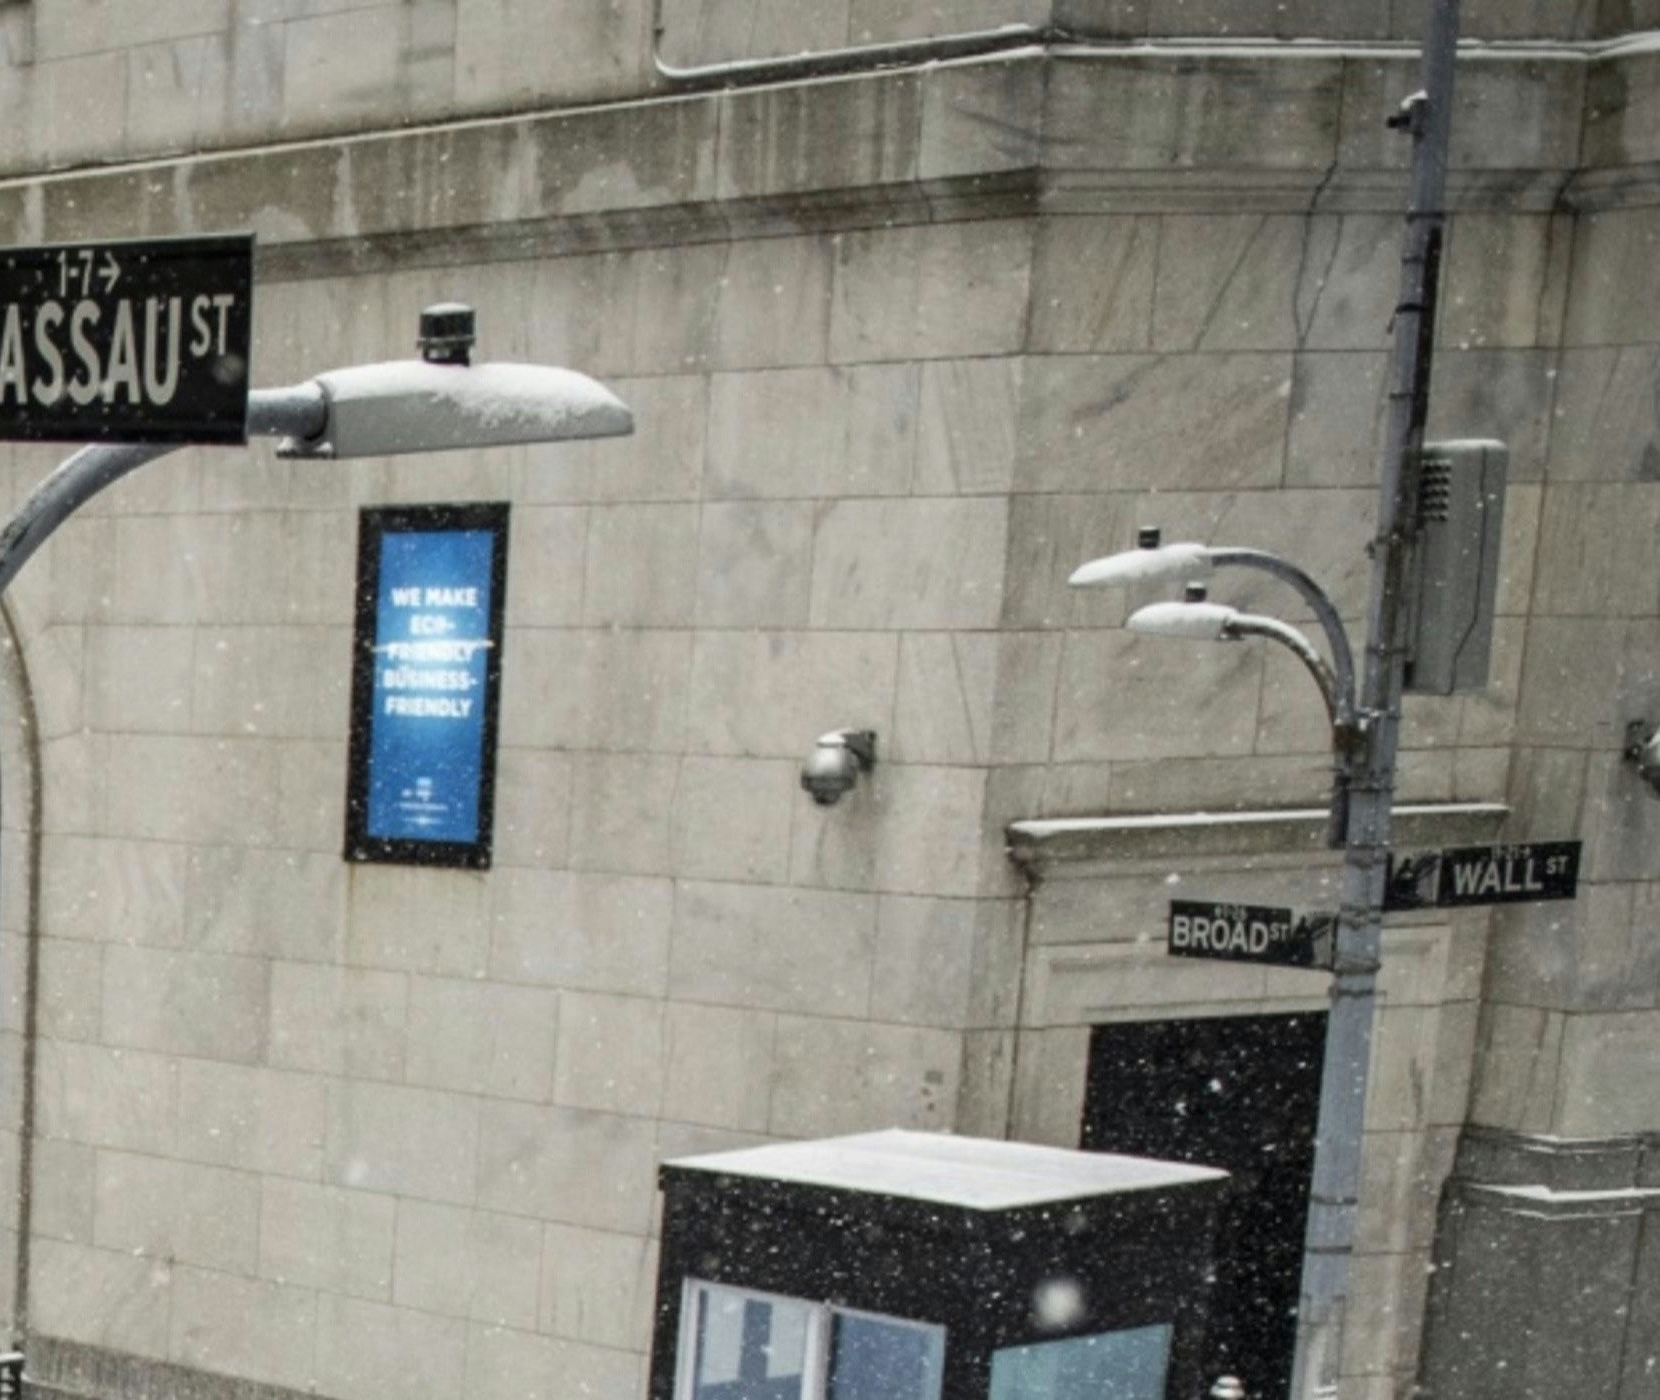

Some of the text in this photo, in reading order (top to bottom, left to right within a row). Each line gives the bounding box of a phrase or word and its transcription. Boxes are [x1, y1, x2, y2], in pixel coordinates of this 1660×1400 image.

[57, 249, 94, 297] 1-7
[189, 294, 234, 357] ST
[391, 587, 478, 608] WE MAKE
[385, 696, 473, 718] FRIENDLY
[1454, 855, 1569, 895] WALL ST
[1172, 915, 1290, 953] BROAD ST
